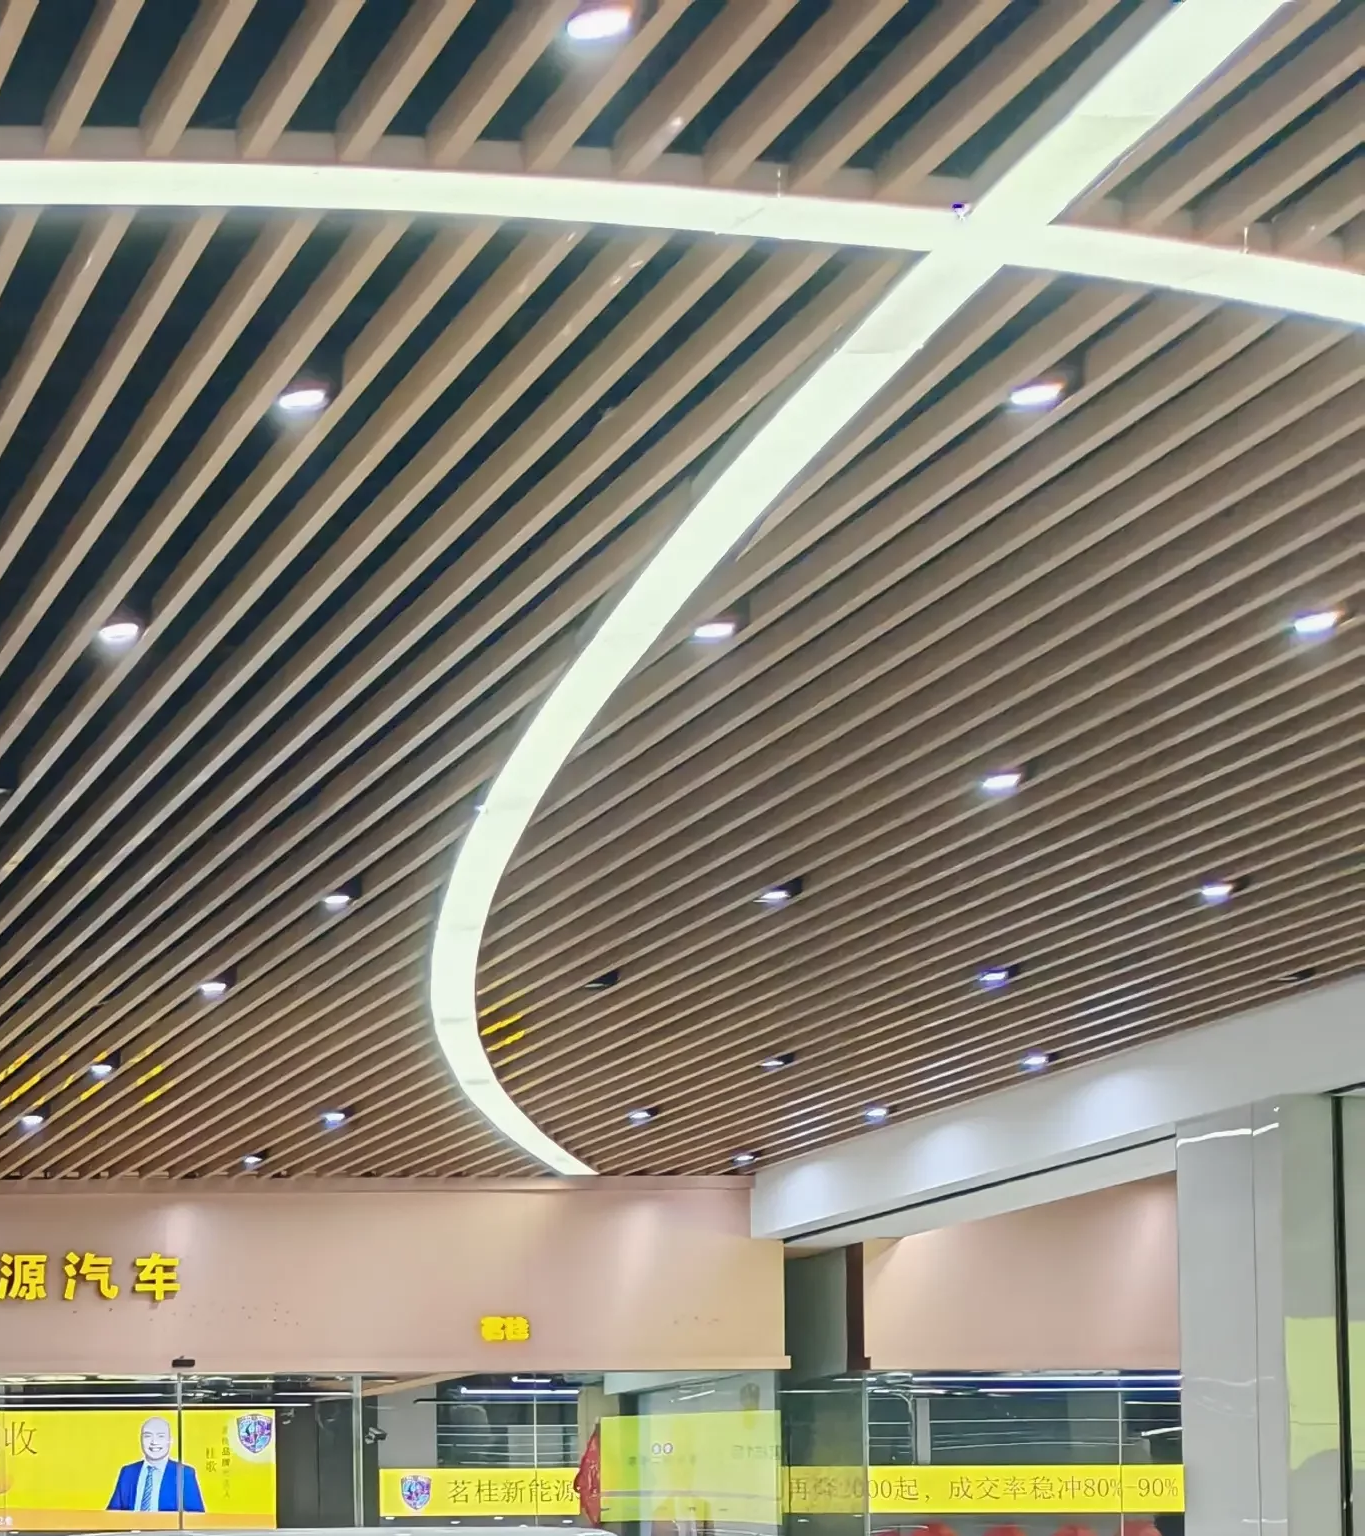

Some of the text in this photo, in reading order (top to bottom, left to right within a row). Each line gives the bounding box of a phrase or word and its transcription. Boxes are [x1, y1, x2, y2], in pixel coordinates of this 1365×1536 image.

[447, 1479, 580, 1504] 茗桂新能源
